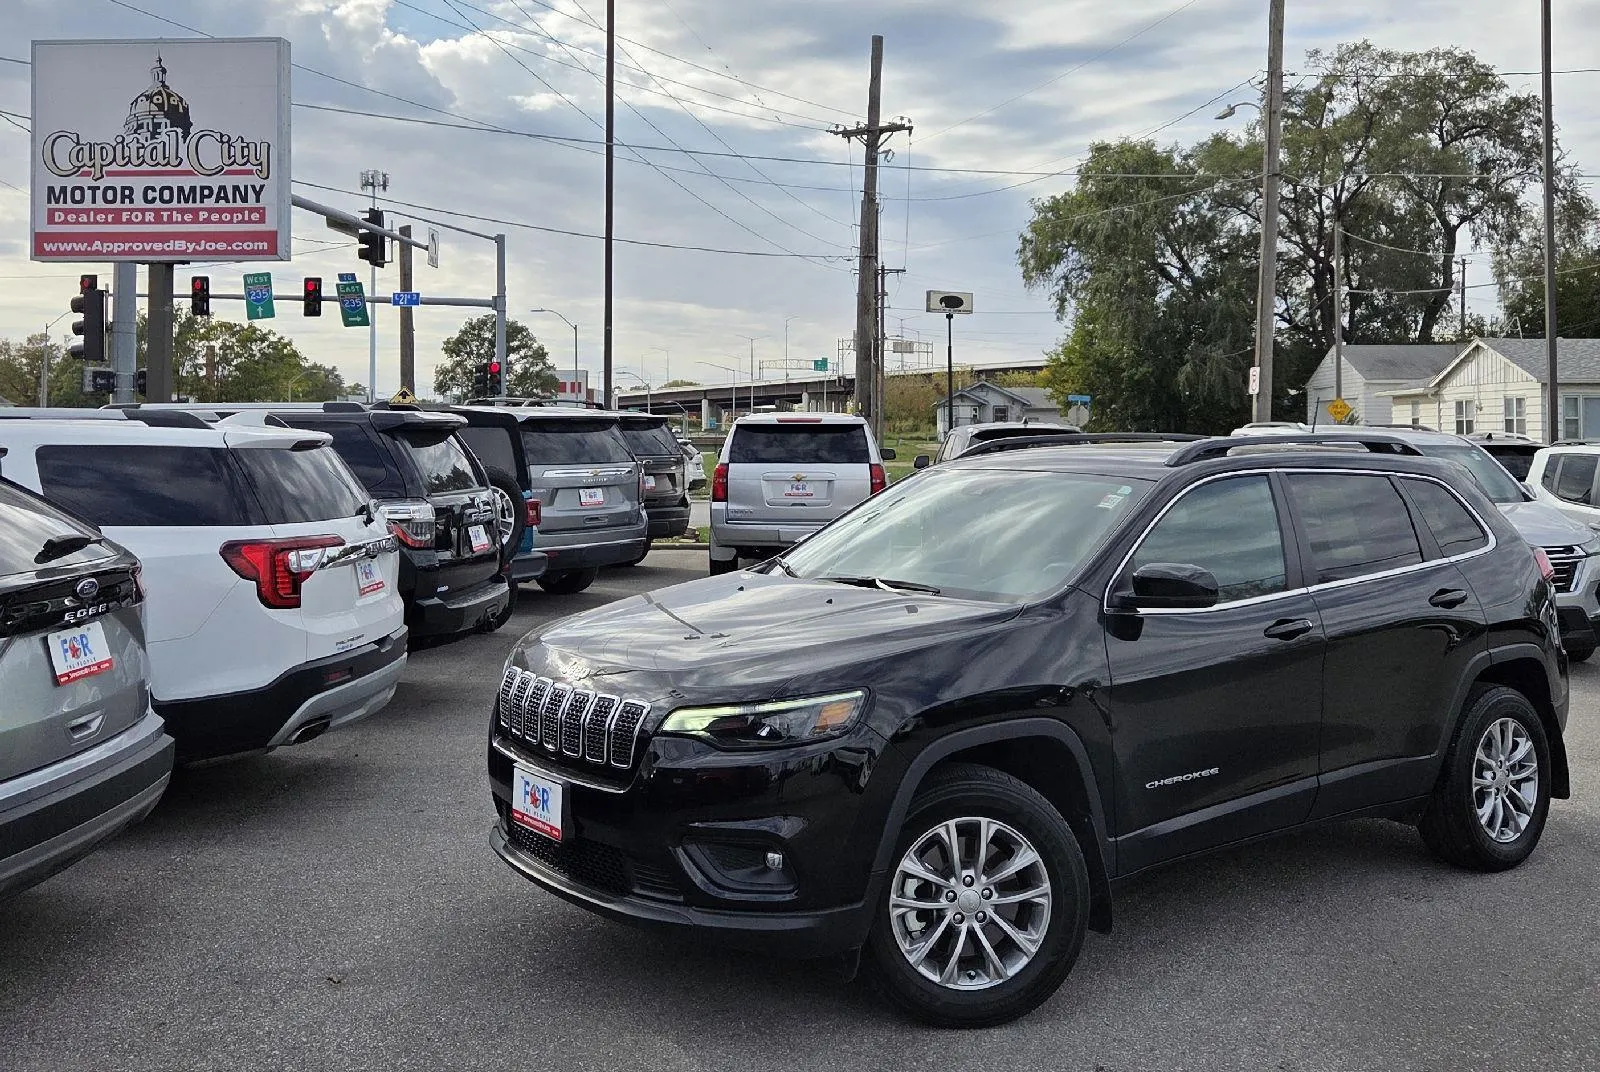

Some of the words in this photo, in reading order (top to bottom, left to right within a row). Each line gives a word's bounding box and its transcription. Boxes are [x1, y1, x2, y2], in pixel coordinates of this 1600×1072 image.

[42, 127, 183, 181] Capital
[187, 128, 270, 180] City
[46, 185, 135, 205] MOTOR
[142, 183, 266, 205] COMPANY
[54, 211, 114, 223] Dealer
[121, 211, 155, 223] FOR
[161, 211, 193, 223] The
[199, 210, 261, 223] People
[43, 239, 268, 253] www.ApprovedByJoe.com
[250, 290, 269, 300] 235
[339, 285, 360, 293] EAST
[343, 298, 362, 308] 235
[61, 633, 94, 662] FOR
[1145, 767, 1219, 789] CHEROKEE
[523, 779, 551, 814] FOR
